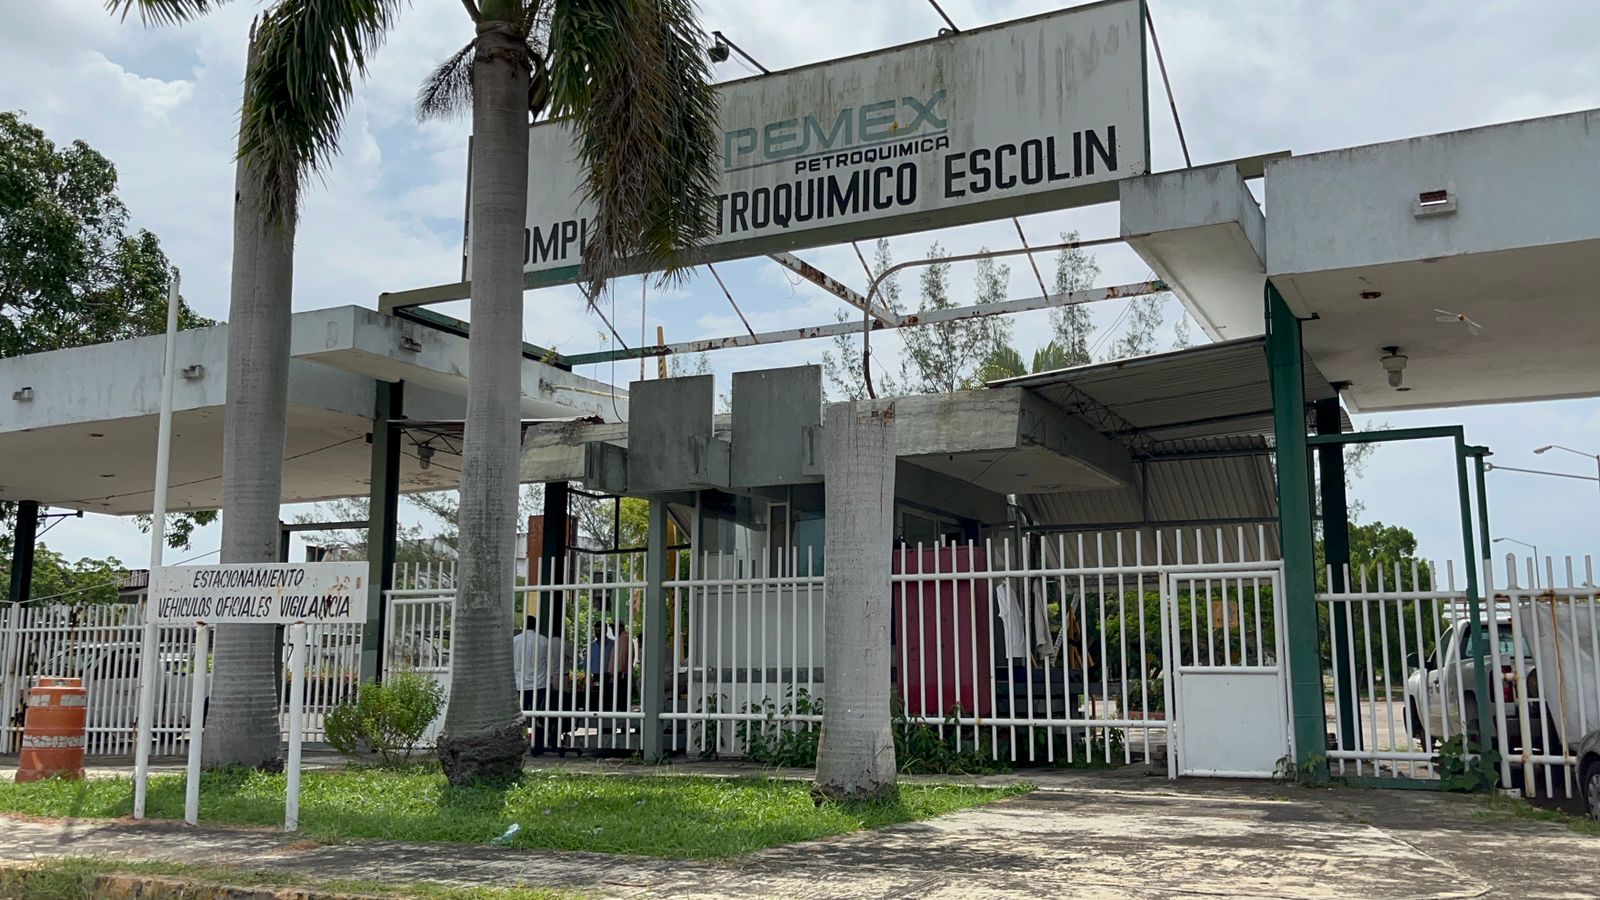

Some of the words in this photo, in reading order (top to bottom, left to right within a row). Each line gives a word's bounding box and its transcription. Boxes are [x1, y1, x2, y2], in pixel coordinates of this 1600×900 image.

[724, 89, 948, 169] PEMEX
[794, 135, 950, 175] PETROQUIMICA
[713, 161, 918, 236] TROQUIMICO
[944, 125, 1119, 199] ESCOLIN
[192, 568, 305, 589] ESTACIONAMIENTO
[158, 596, 213, 619] VEHICULOS
[215, 596, 272, 618] OFICIALES
[279, 595, 350, 620] VIGILANCIA
